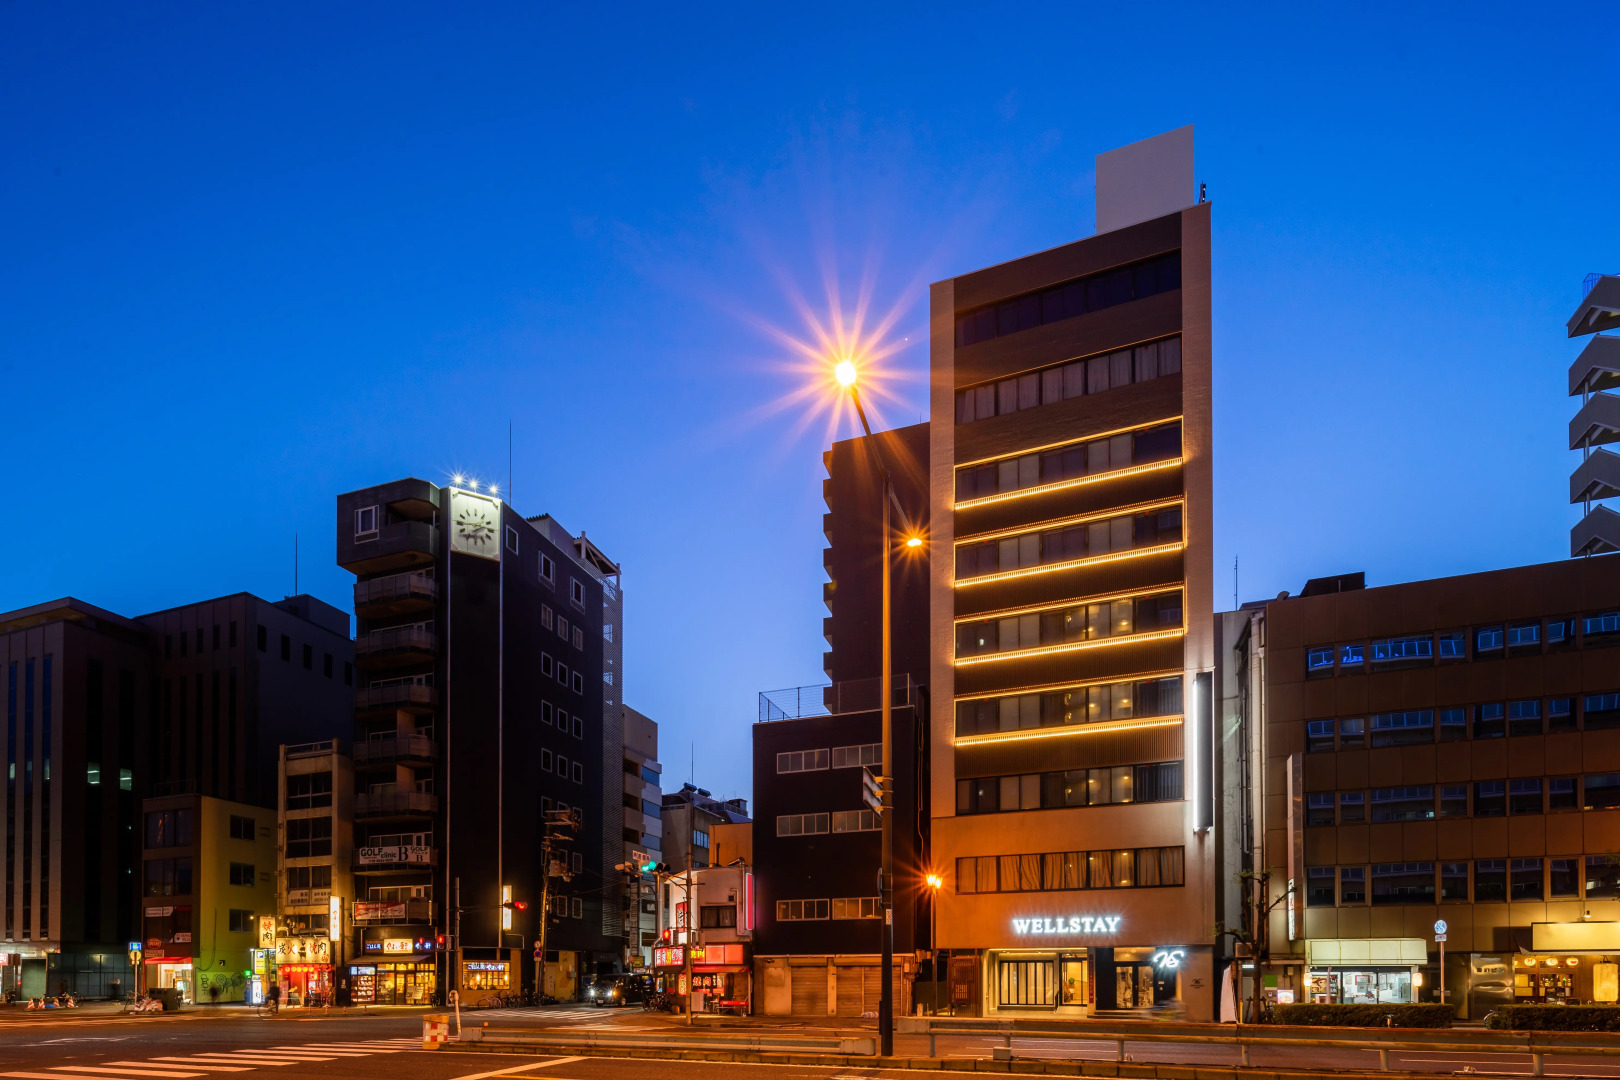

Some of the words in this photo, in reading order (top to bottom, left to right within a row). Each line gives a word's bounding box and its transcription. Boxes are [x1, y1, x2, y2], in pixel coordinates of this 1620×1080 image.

[361, 848, 384, 856] GOLF
[397, 846, 409, 862] B
[262, 920, 274, 942] 焼肉
[1012, 917, 1122, 935] WELLSTAY
[277, 942, 296, 956] 炭火
[309, 941, 327, 955] 焼肉
